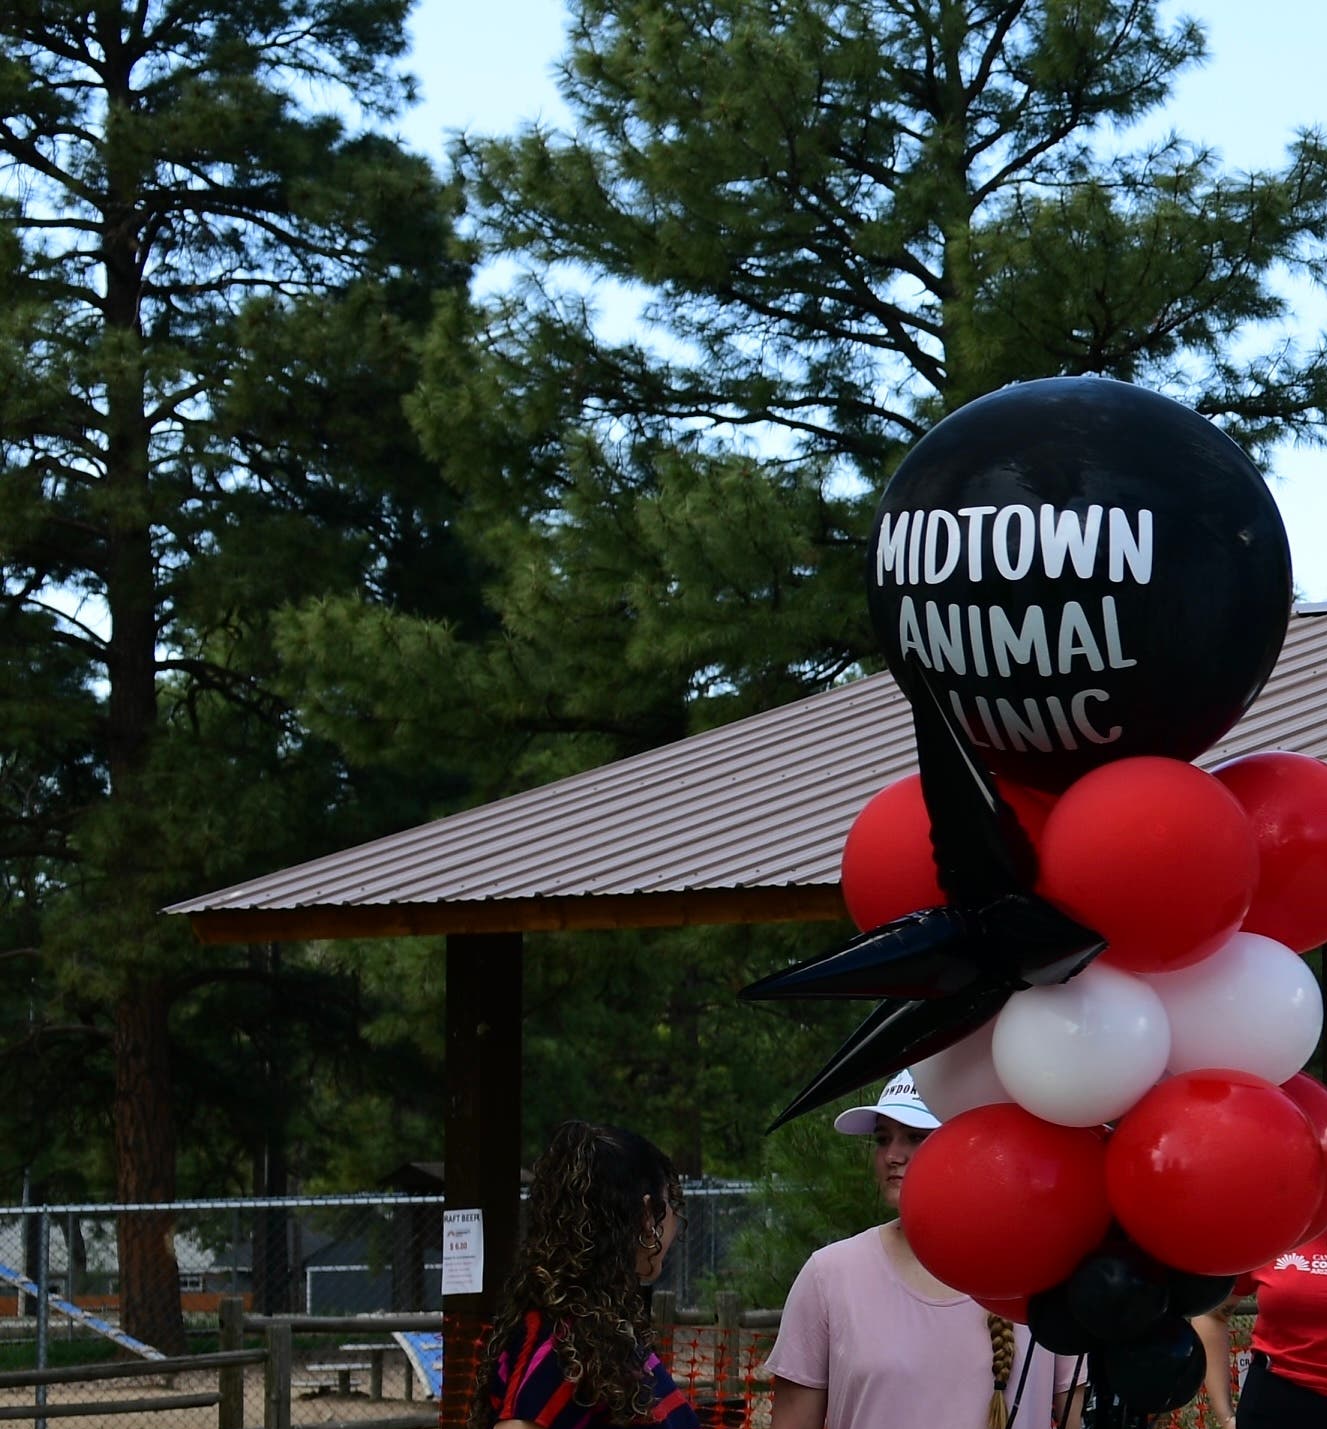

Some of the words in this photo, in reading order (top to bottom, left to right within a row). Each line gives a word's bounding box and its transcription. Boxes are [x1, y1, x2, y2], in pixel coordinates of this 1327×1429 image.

[876, 503, 1154, 586] MIDTOWN
[900, 595, 1138, 678] ANIMAL
[948, 687, 1124, 753] LINIC
[444, 1214, 460, 1222] RAFT
[461, 1213, 480, 1222] BEER
